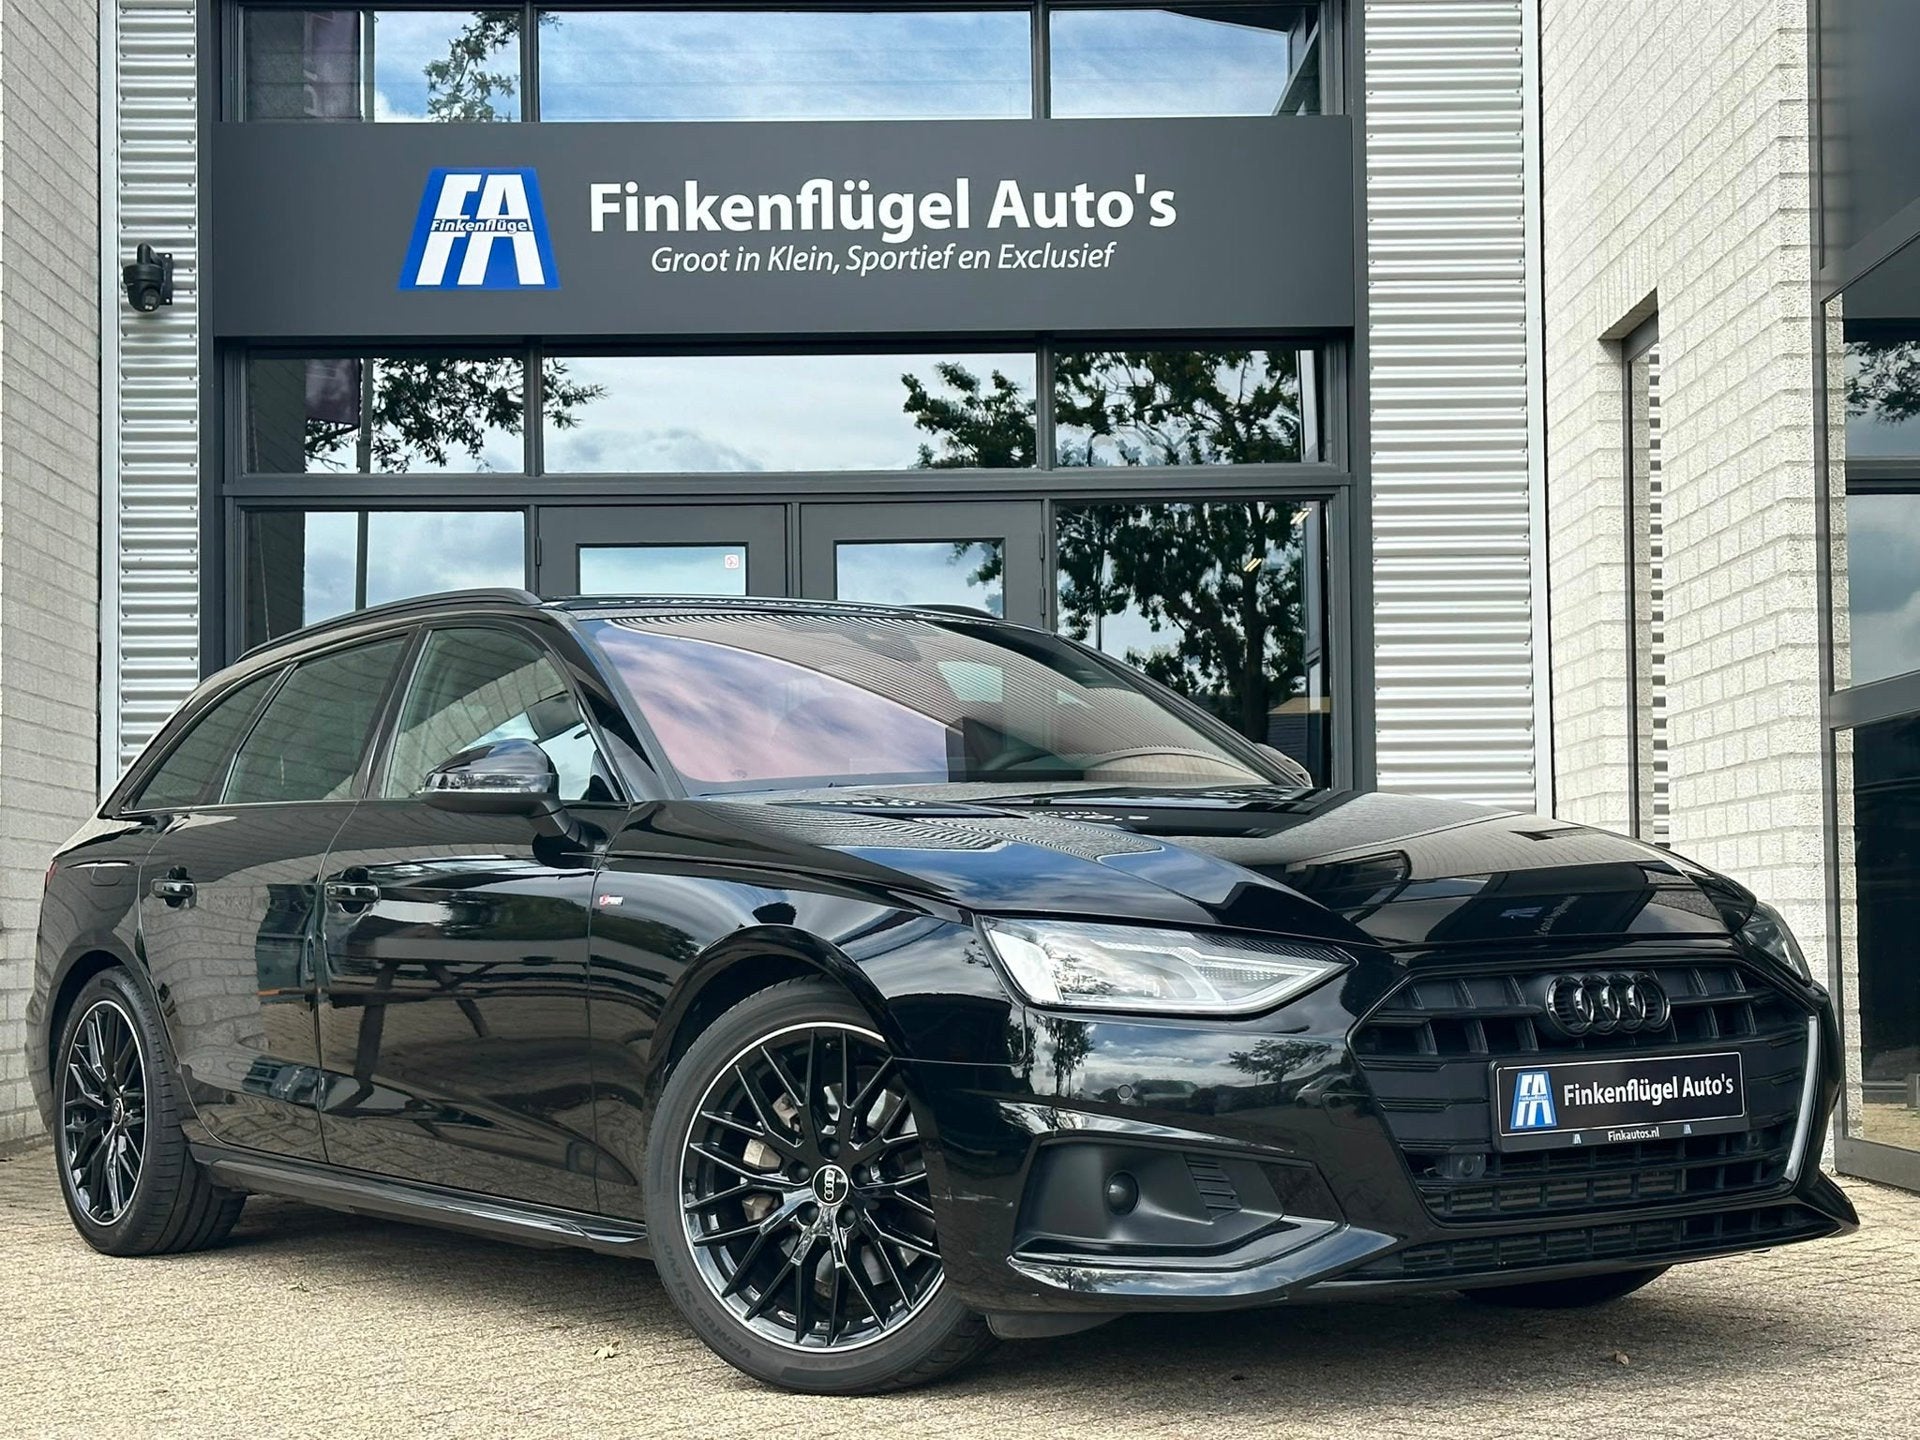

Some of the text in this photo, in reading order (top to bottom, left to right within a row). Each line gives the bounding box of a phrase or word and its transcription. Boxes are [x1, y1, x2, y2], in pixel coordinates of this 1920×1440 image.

[590, 173, 1177, 244] Finkenflügel Auto's
[430, 219, 534, 234] Finkenflügel
[651, 241, 1118, 277] Groot in Klein, Sportief en Exclusief
[1563, 1073, 1735, 1107] Finkenflügel Auto's
[1607, 1126, 1660, 1142] Finkautos.nl
